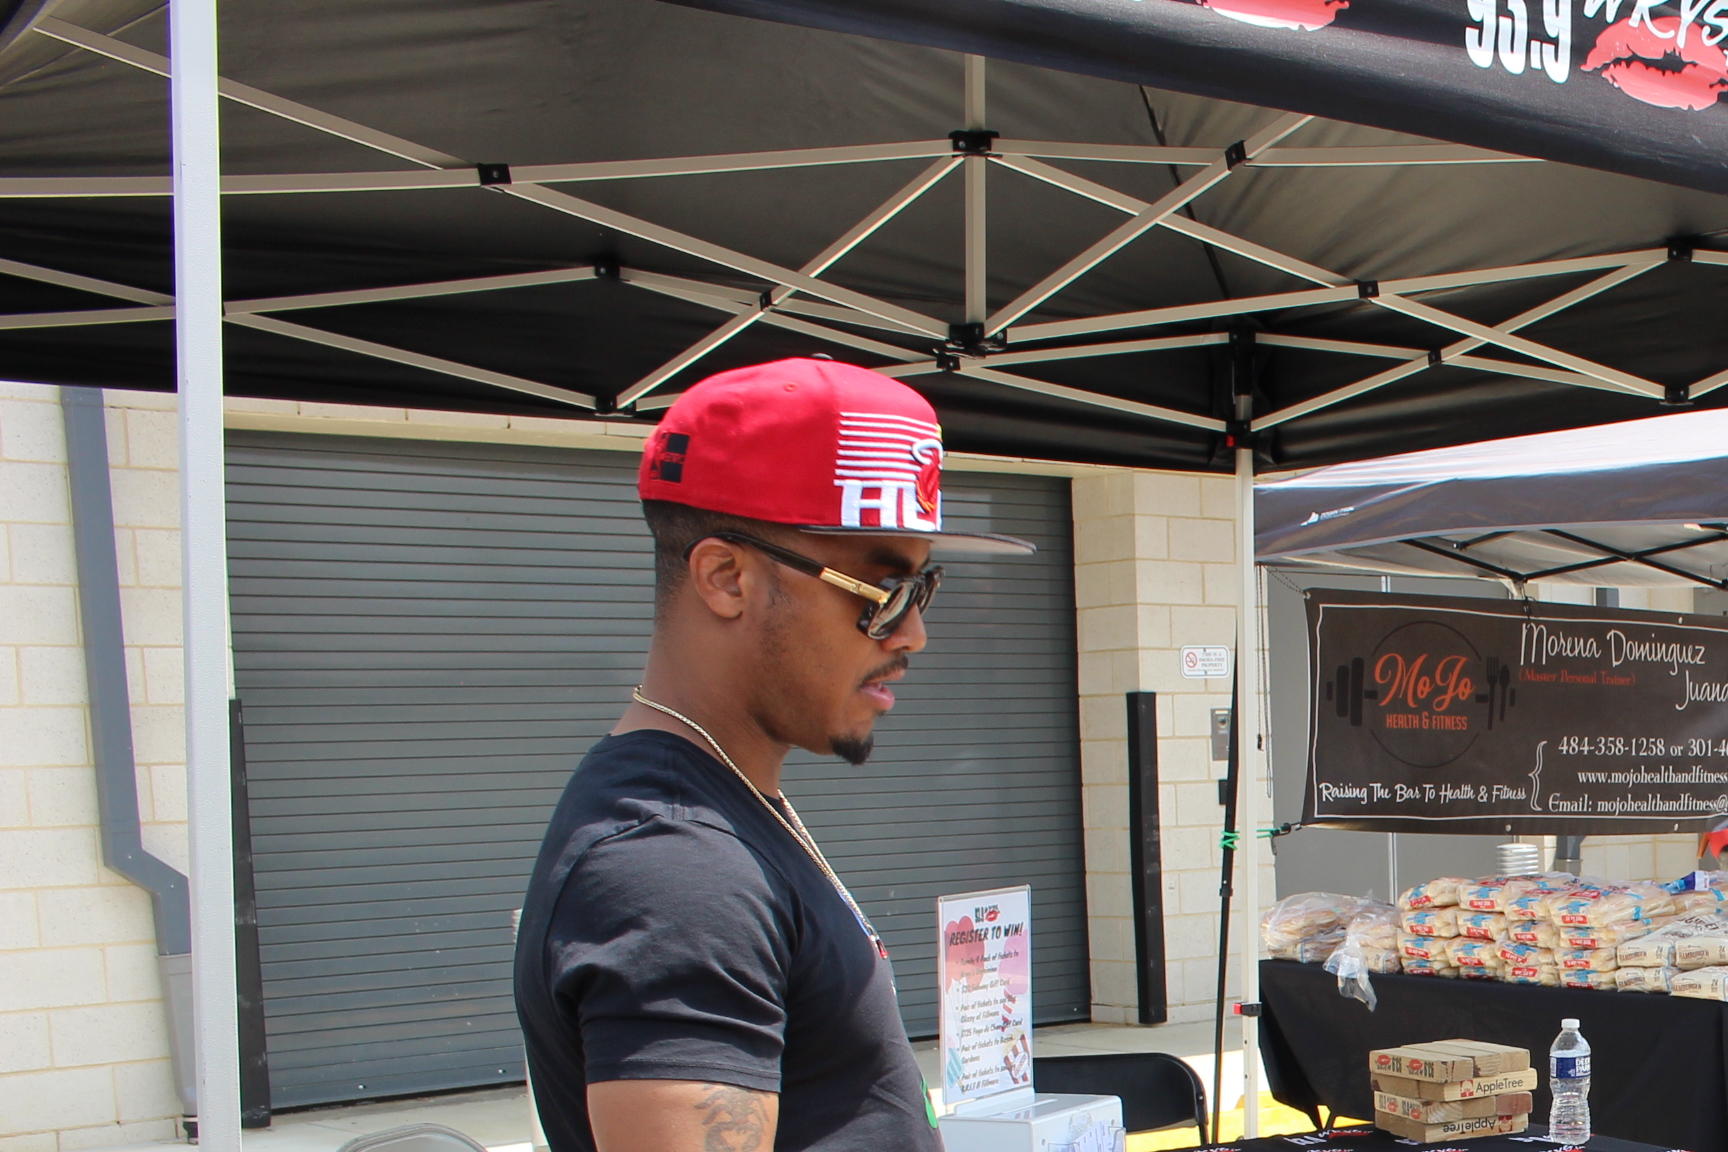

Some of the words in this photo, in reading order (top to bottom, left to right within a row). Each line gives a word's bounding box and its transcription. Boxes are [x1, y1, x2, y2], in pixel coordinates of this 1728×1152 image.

[1519, 622, 1602, 666] Morena
[1606, 629, 1706, 676] Dominguez
[1560, 669, 1598, 685] Personal
[1386, 714, 1420, 729] HEALTH
[1421, 711, 1431, 729] &
[1432, 716, 1468, 731] FITNESS
[1558, 736, 1666, 756] 484-358-1258
[1670, 746, 1684, 757] or
[1319, 782, 1368, 804] Raising
[1370, 783, 1391, 800] The
[1395, 783, 1421, 803] Bar
[1423, 784, 1436, 801] To
[1439, 784, 1475, 804] Health
[1477, 786, 1489, 802] &
[1492, 785, 1527, 803] Fitness
[1549, 793, 1593, 813] Email:
[950, 929, 989, 946] REGISTER
[991, 927, 1001, 940] TO
[1003, 921, 1024, 938] WIN!
[1475, 1077, 1524, 1095] AppleTree
[1442, 1118, 1497, 1134] AppleTree
